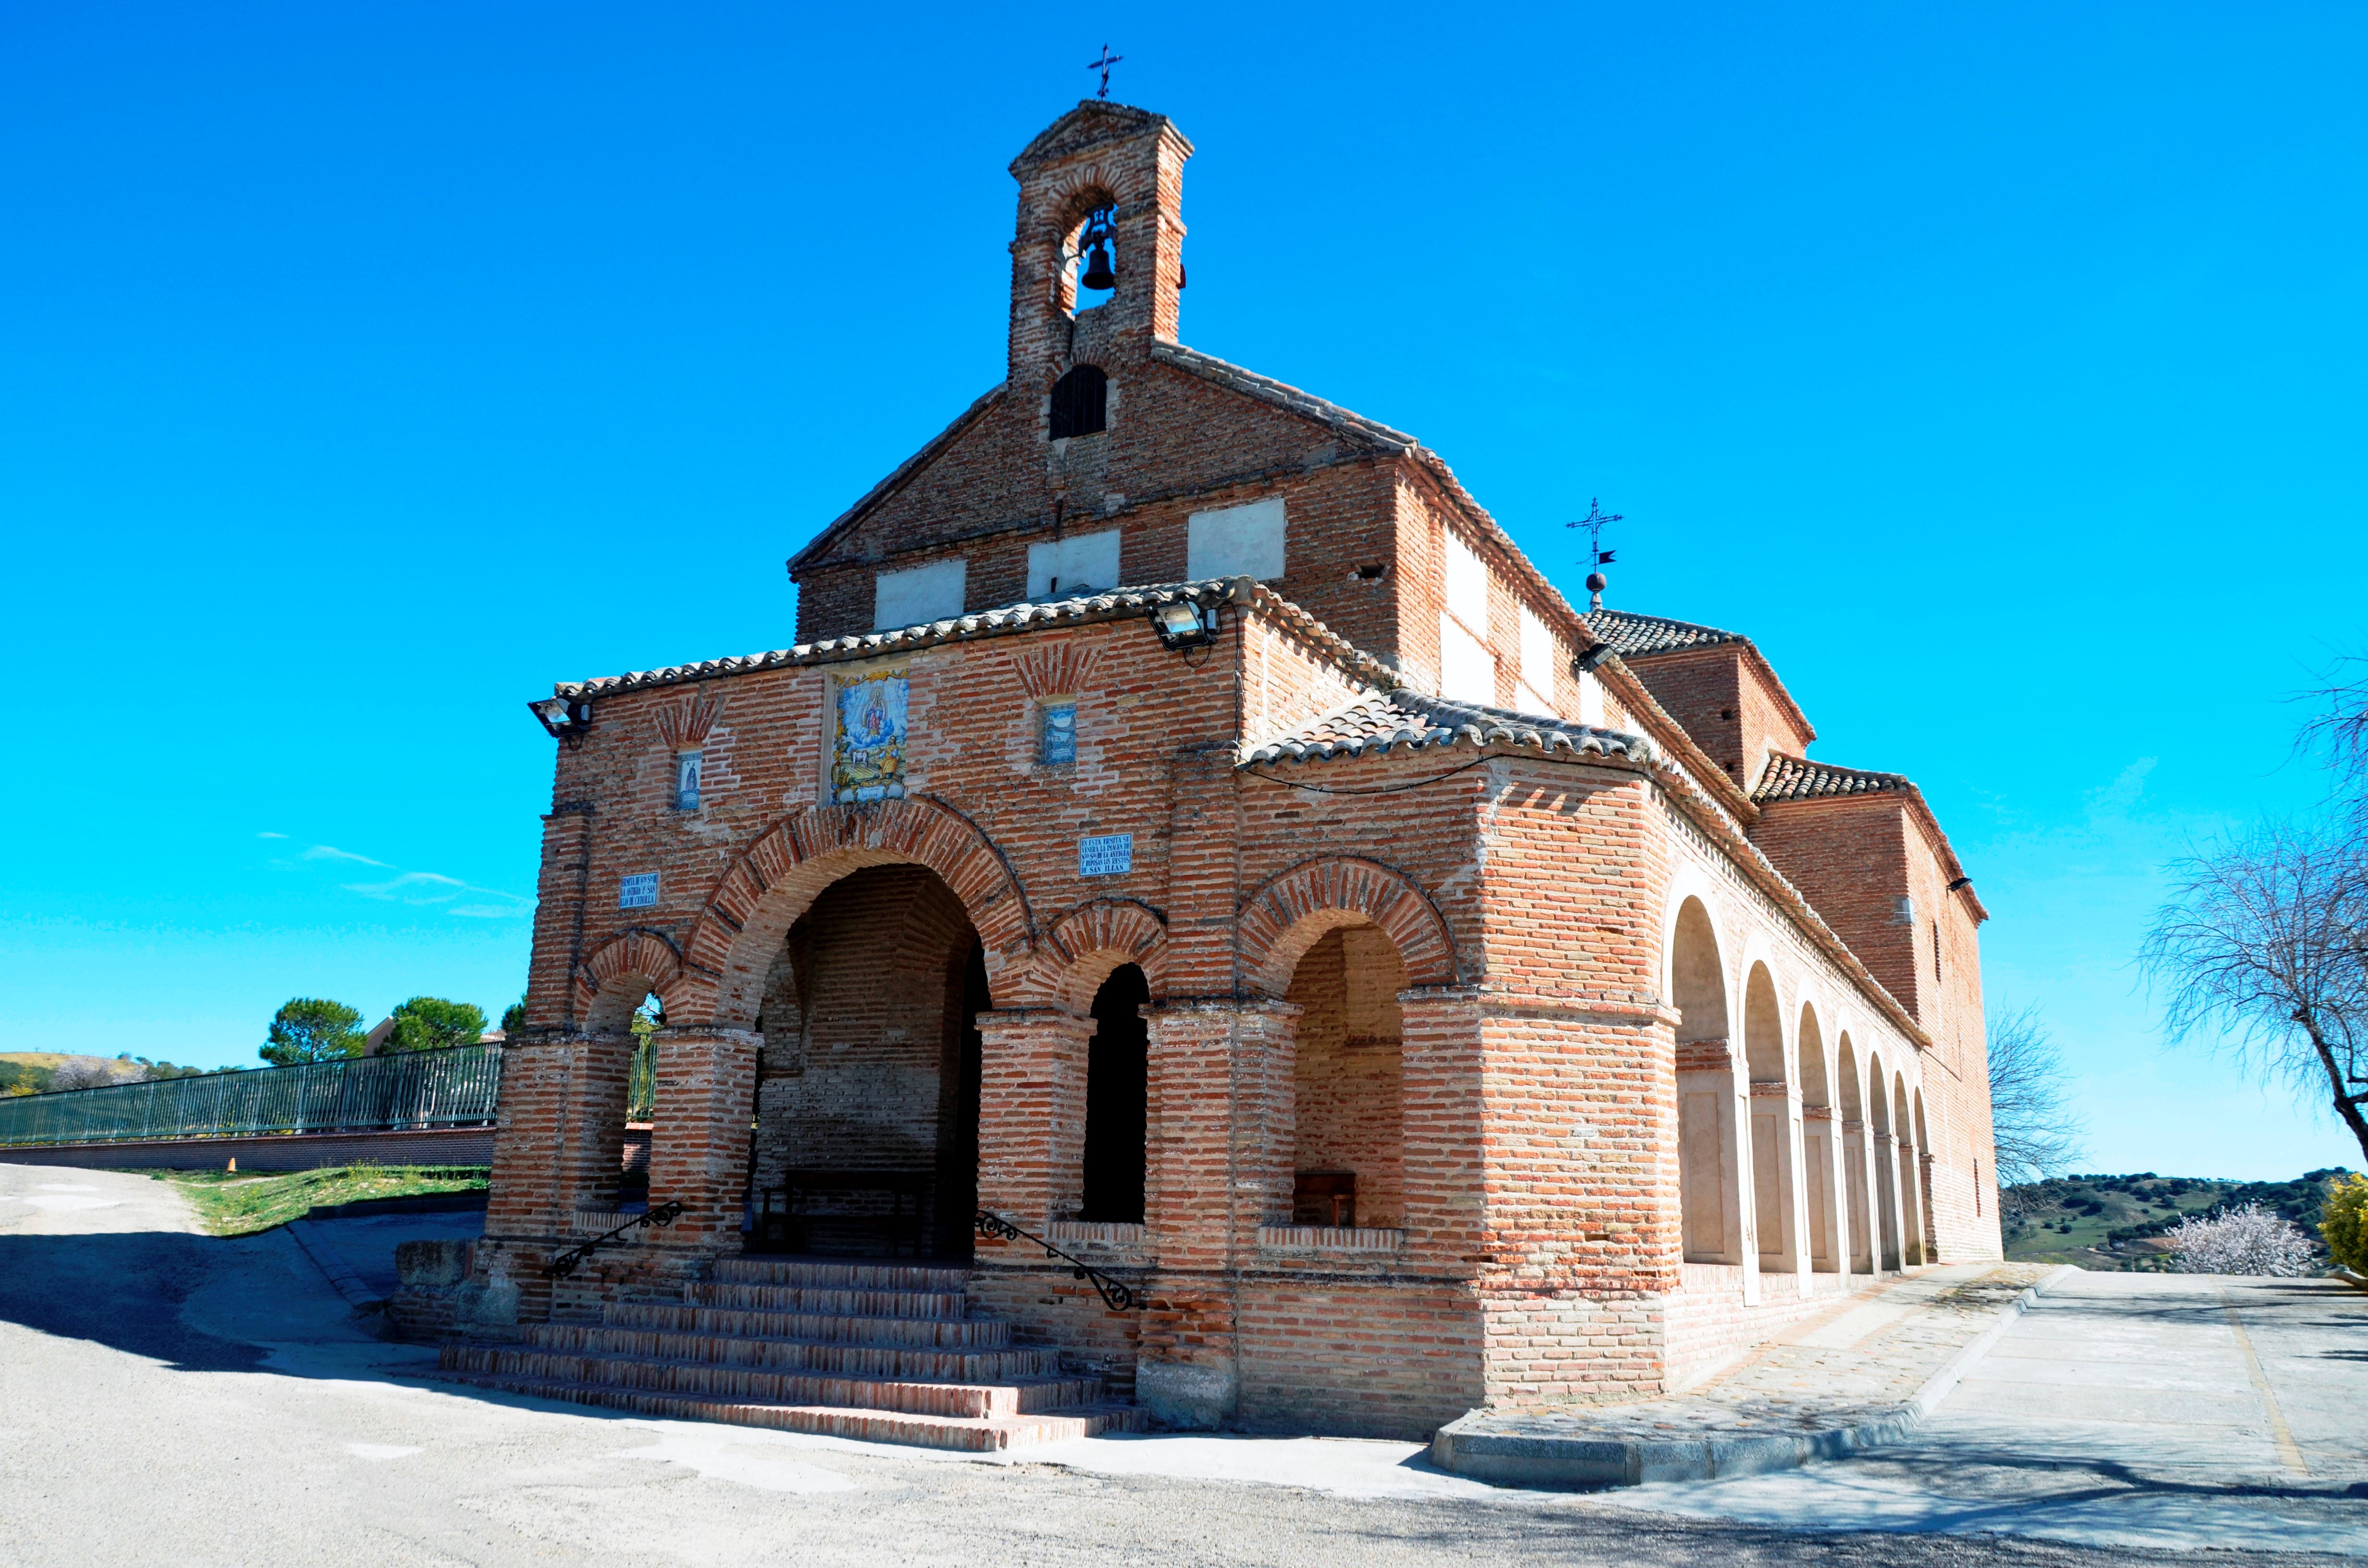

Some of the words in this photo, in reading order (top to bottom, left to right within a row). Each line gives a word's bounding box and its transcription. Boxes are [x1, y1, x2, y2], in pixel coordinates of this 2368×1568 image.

[622, 877, 635, 886] ERMITA
[636, 876, 640, 885] DE
[621, 888, 625, 896] LA
[627, 886, 641, 896] ANTIGUA
[642, 886, 645, 894] Y
[647, 885, 655, 894] SAN
[629, 896, 633, 905] DE
[635, 895, 654, 905] CEBOLLA
